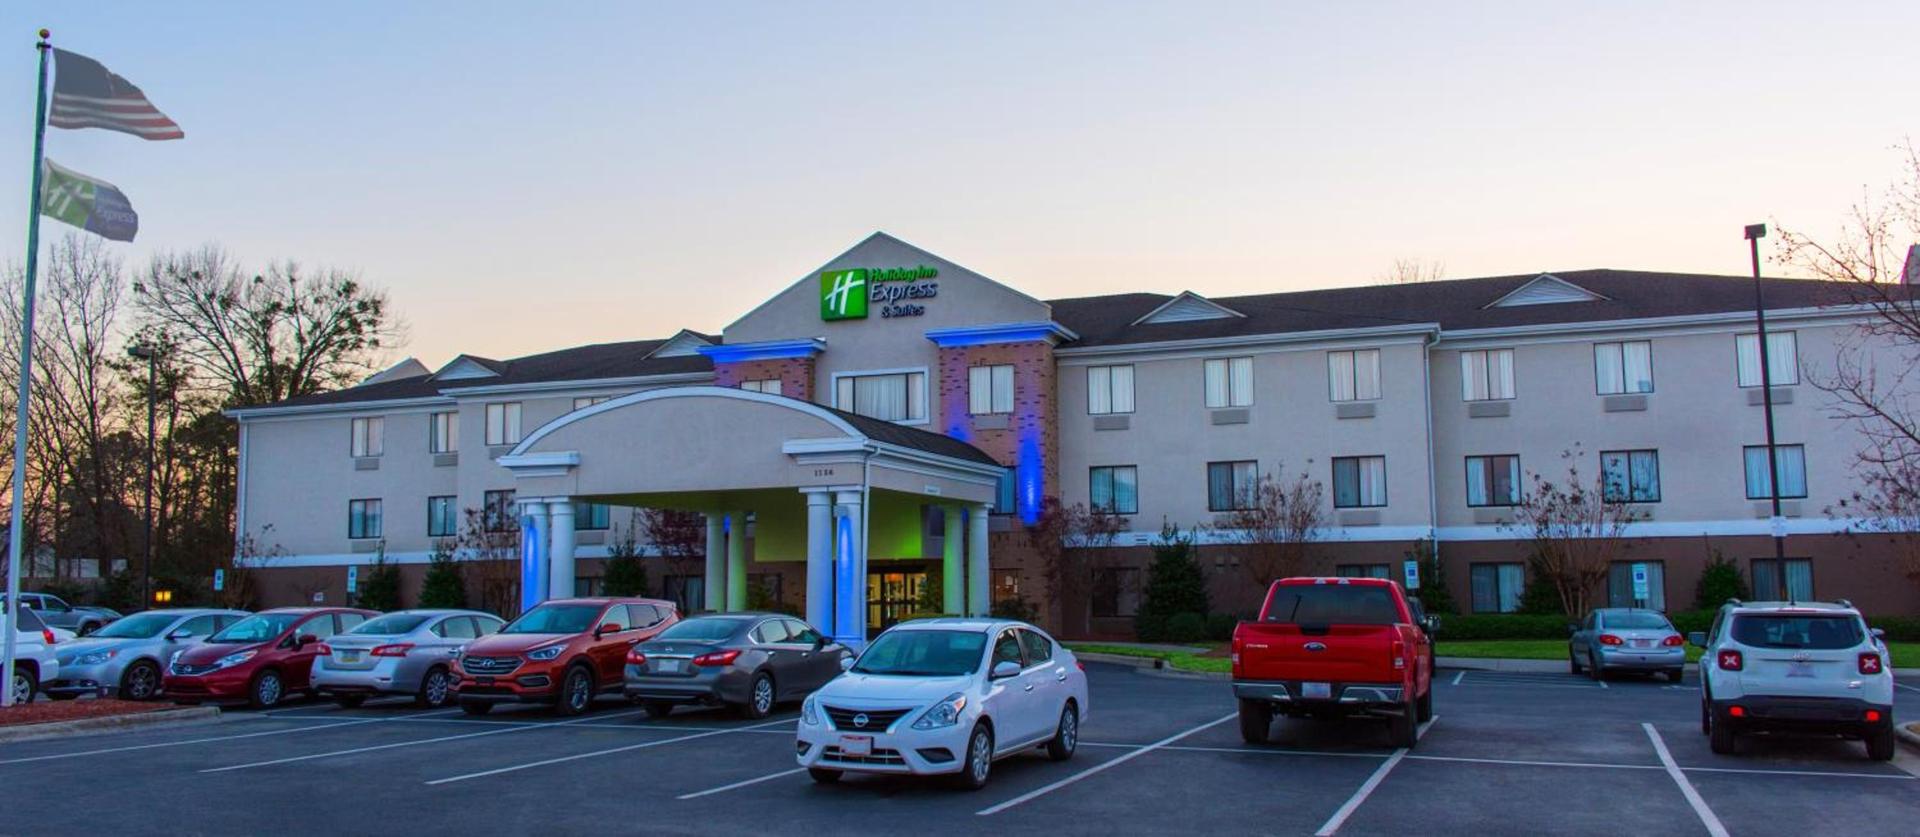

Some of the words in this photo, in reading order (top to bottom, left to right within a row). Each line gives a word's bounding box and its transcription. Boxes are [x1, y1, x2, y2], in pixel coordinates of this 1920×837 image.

[871, 267, 917, 282] Holiday
[918, 264, 938, 278] Inn
[871, 282, 938, 305] Express
[881, 305, 891, 318] &
[892, 304, 925, 317] Suites
